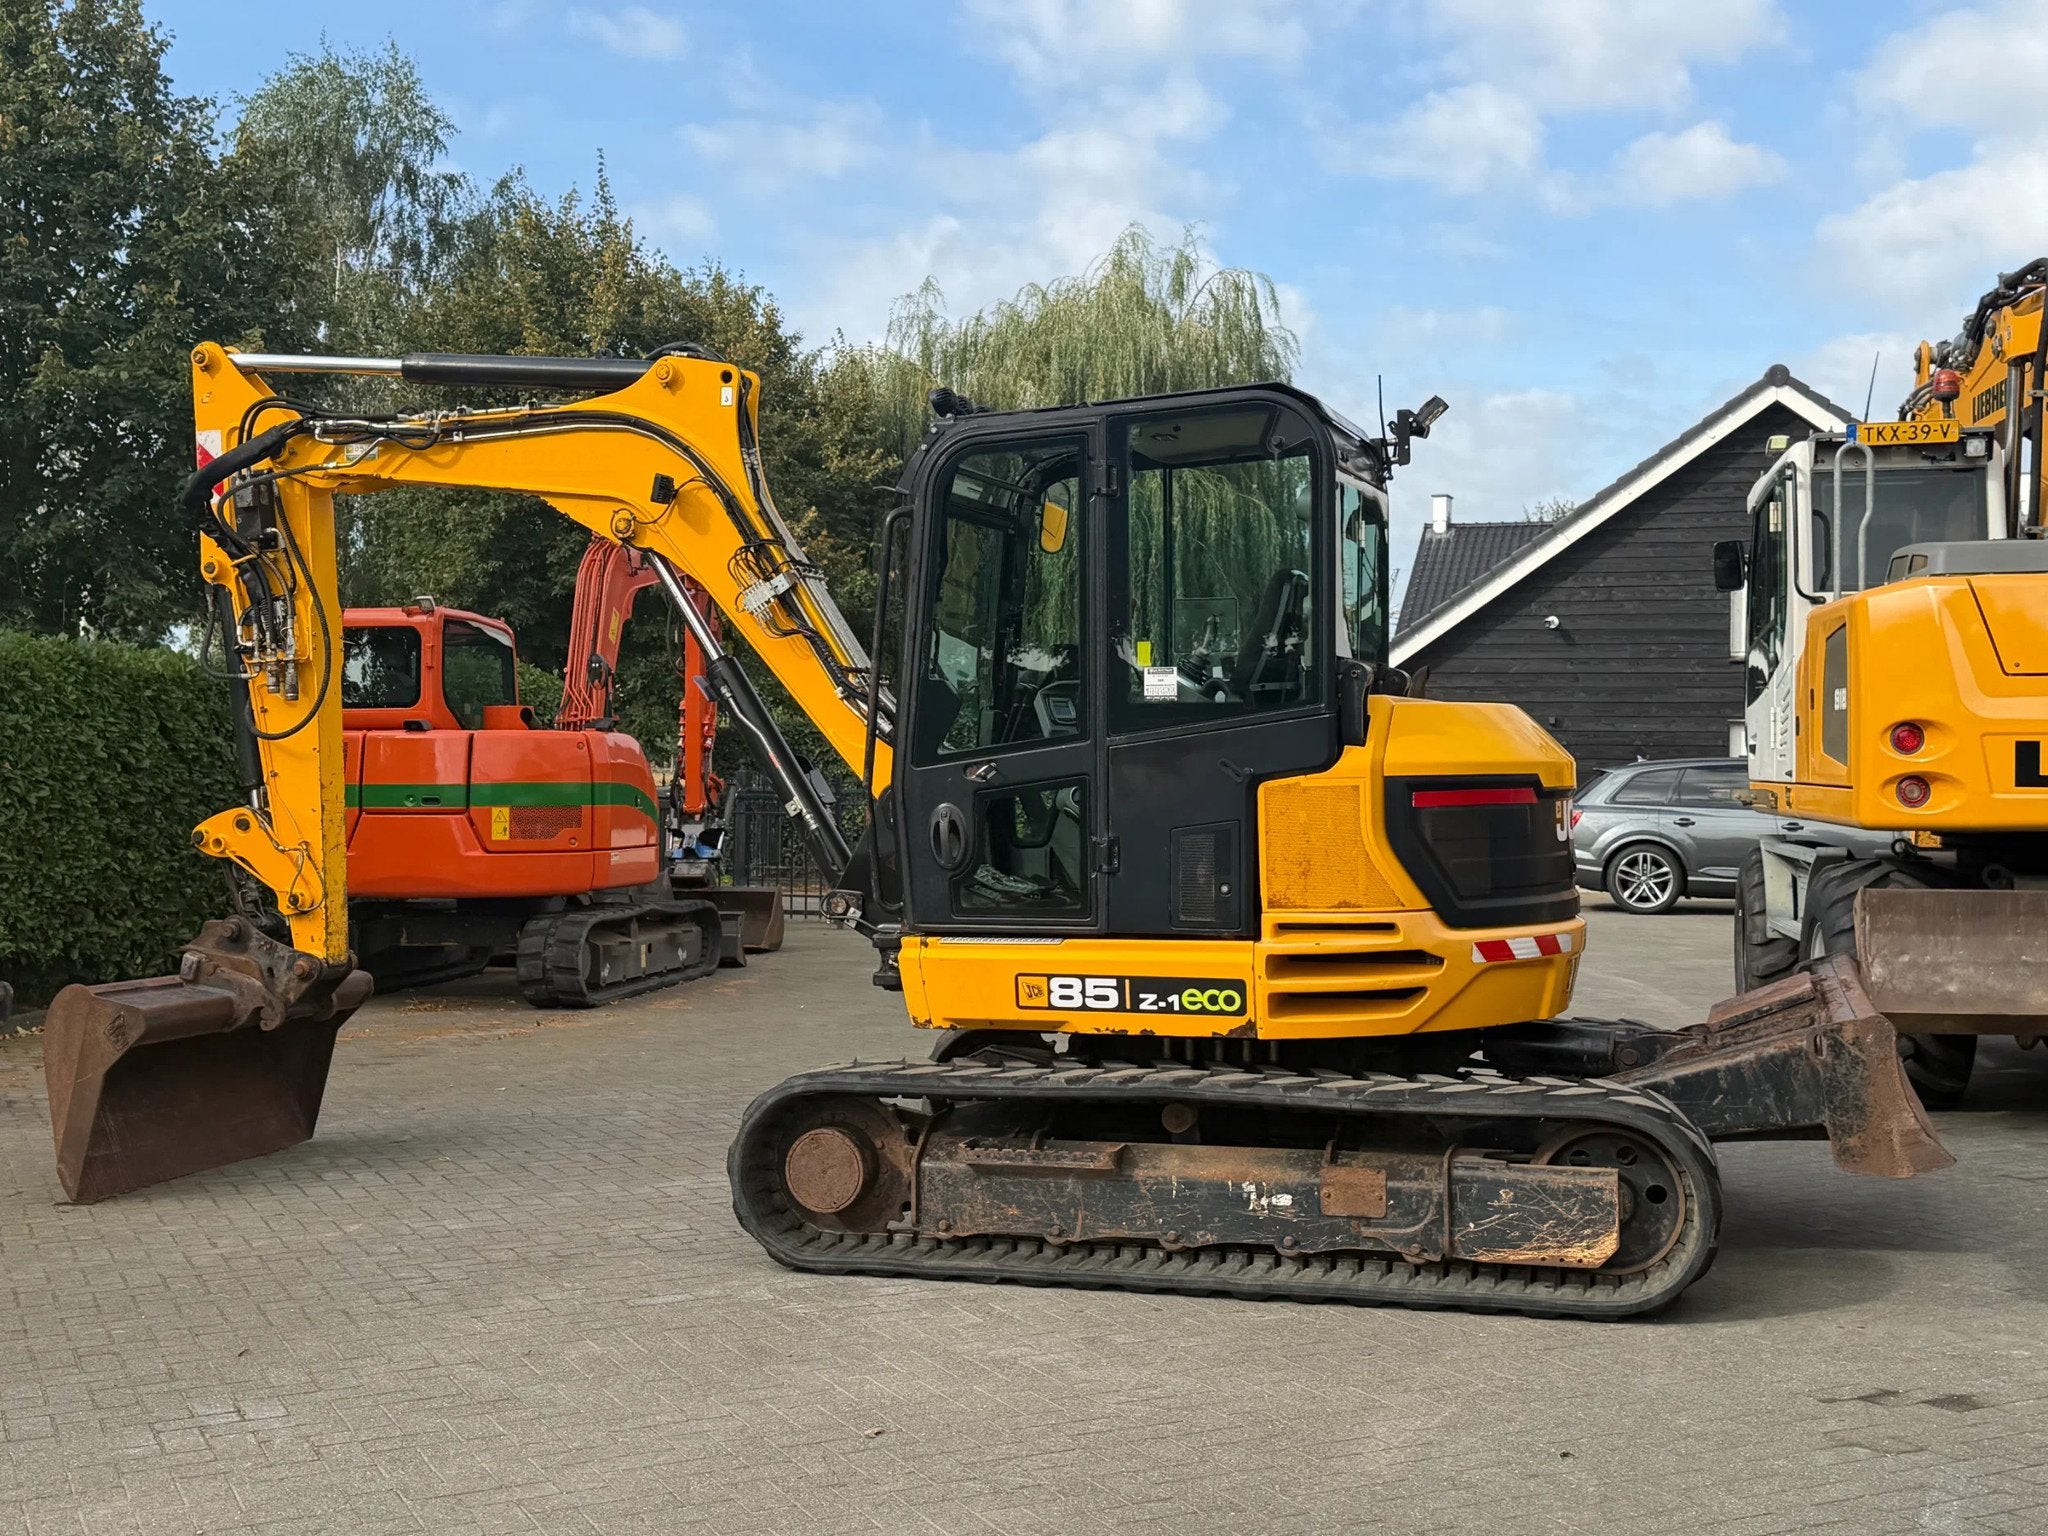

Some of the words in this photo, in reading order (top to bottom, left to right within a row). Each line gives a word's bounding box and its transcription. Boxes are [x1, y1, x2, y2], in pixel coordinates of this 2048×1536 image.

[1973, 377, 2007, 424] LIEBHE
[1864, 423, 1951, 442] TKX-39-V
[1050, 977, 1119, 1009] 85
